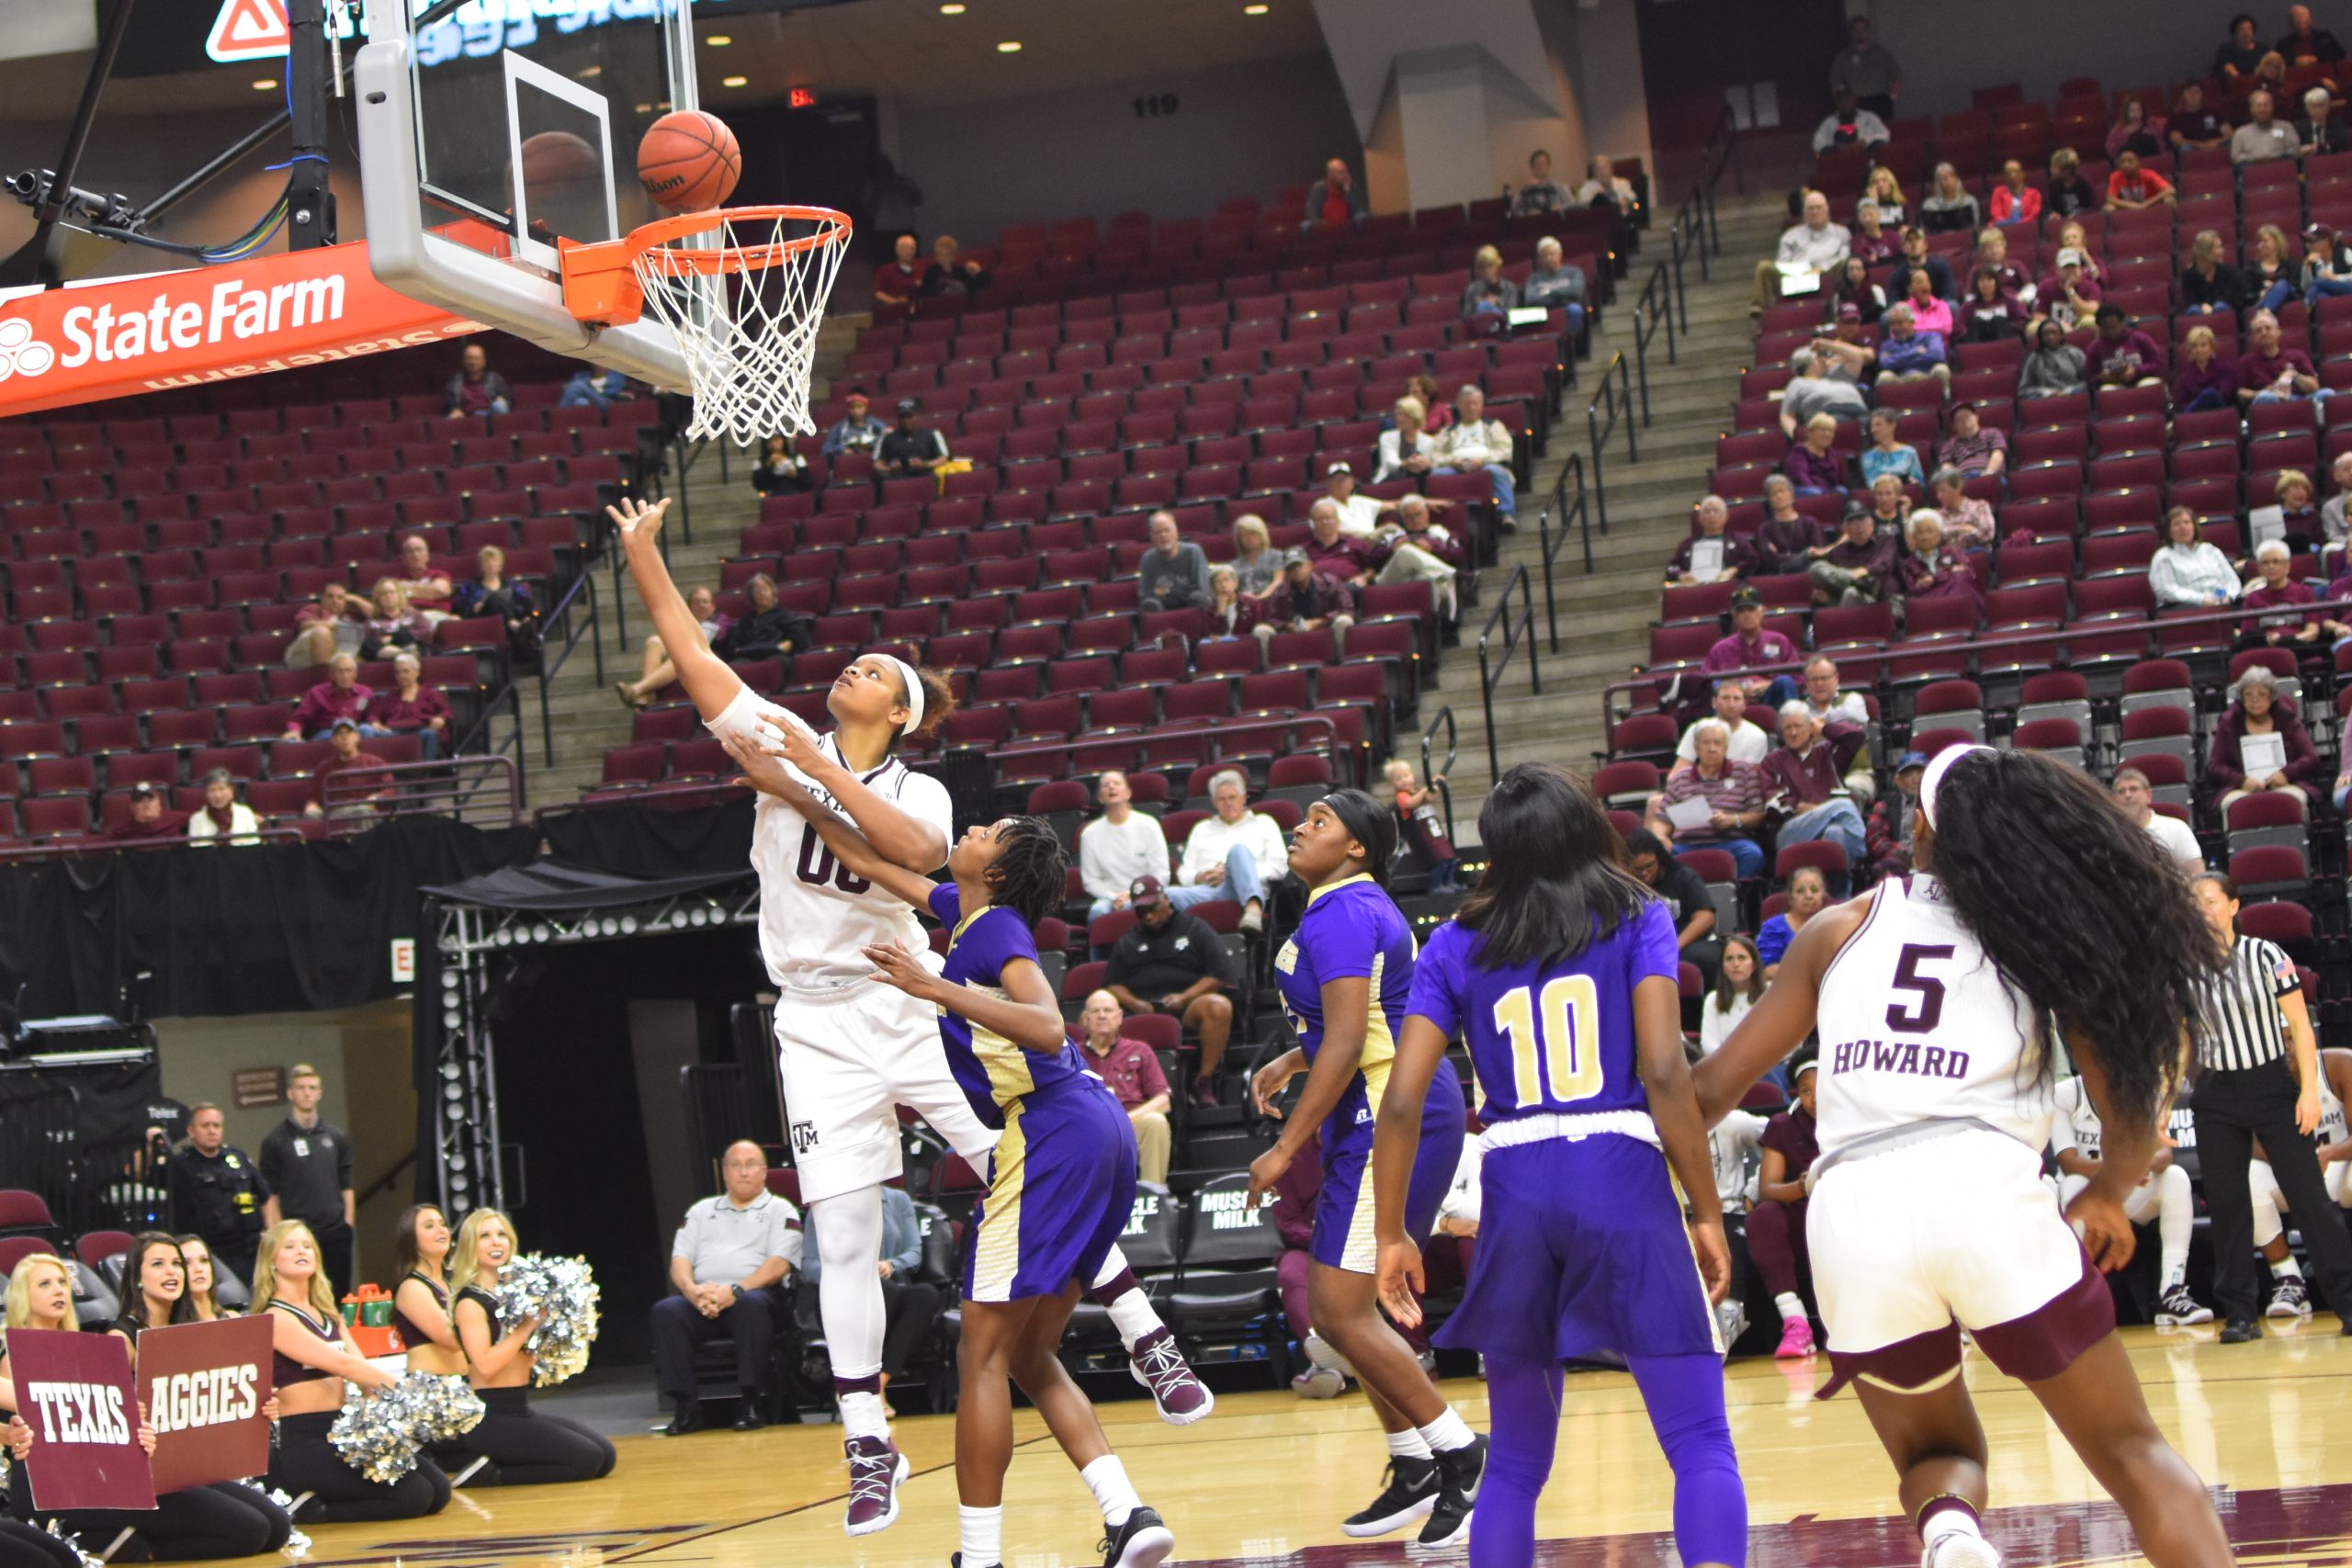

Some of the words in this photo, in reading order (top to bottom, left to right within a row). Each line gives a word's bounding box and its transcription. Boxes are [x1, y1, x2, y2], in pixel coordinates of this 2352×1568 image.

[1885, 943, 1956, 1034] 5
[1494, 974, 1604, 1110] 10
[1833, 1039, 1971, 1080] HOWARD
[2074, 1129, 2099, 1145] TEX
[1201, 1190, 1274, 1212] MUSE
[1213, 1208, 1261, 1229] MILK
[28, 1382, 130, 1445] TEXAS
[151, 1363, 258, 1435] AGGIES
